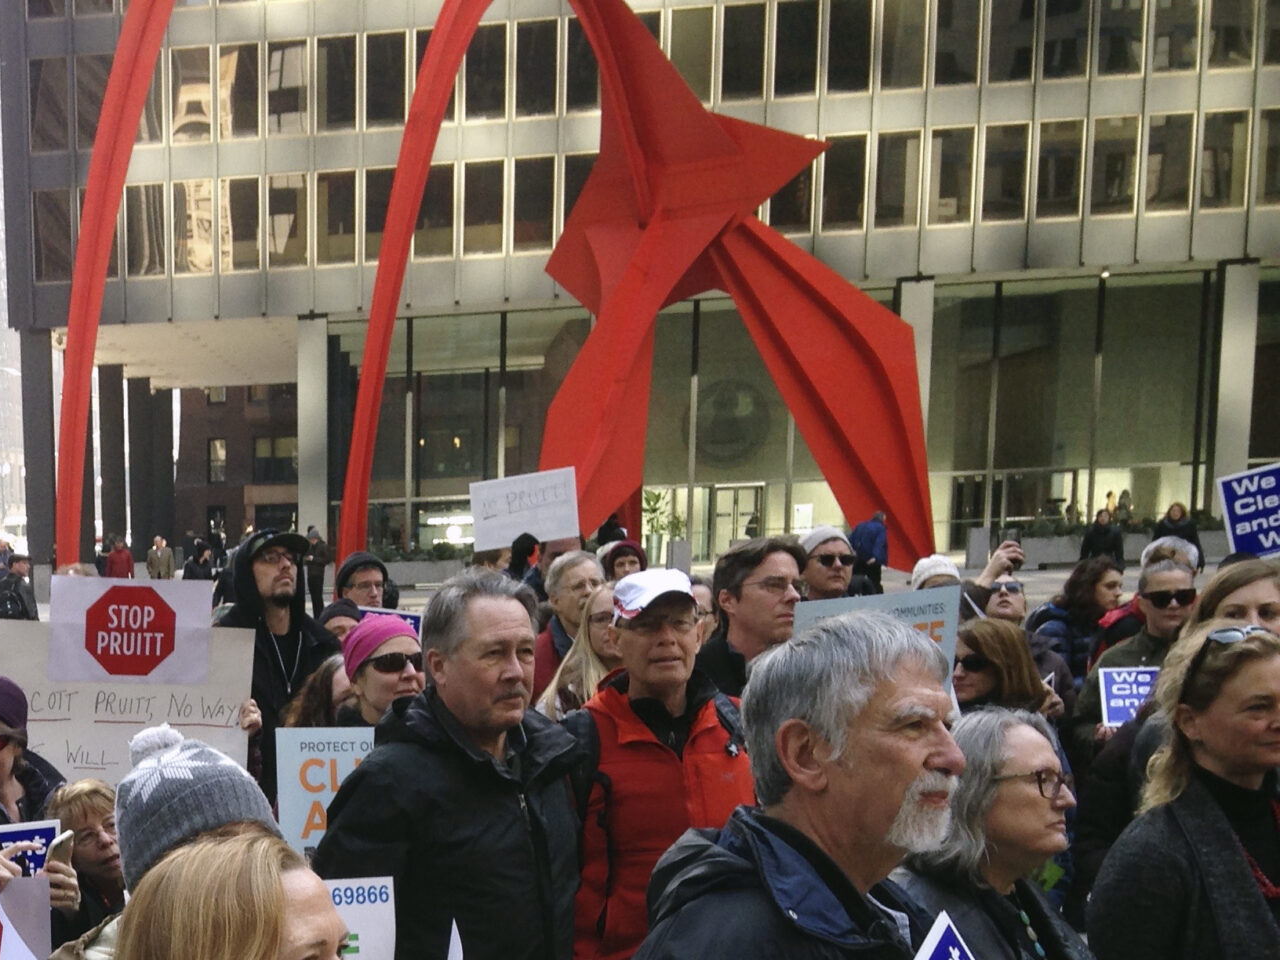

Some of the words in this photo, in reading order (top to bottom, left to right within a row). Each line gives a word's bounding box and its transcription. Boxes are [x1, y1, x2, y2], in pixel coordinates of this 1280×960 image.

[1231, 475, 1276, 495] We
[1234, 494, 1280, 515] Cle
[107, 604, 156, 629] STOP
[96, 631, 165, 658] PRUITT
[1112, 683, 1150, 695] Cle
[30, 691, 79, 713] COTT
[66, 740, 119, 766] WILL
[300, 742, 356, 752] PROTECT
[332, 885, 390, 906] 69866
